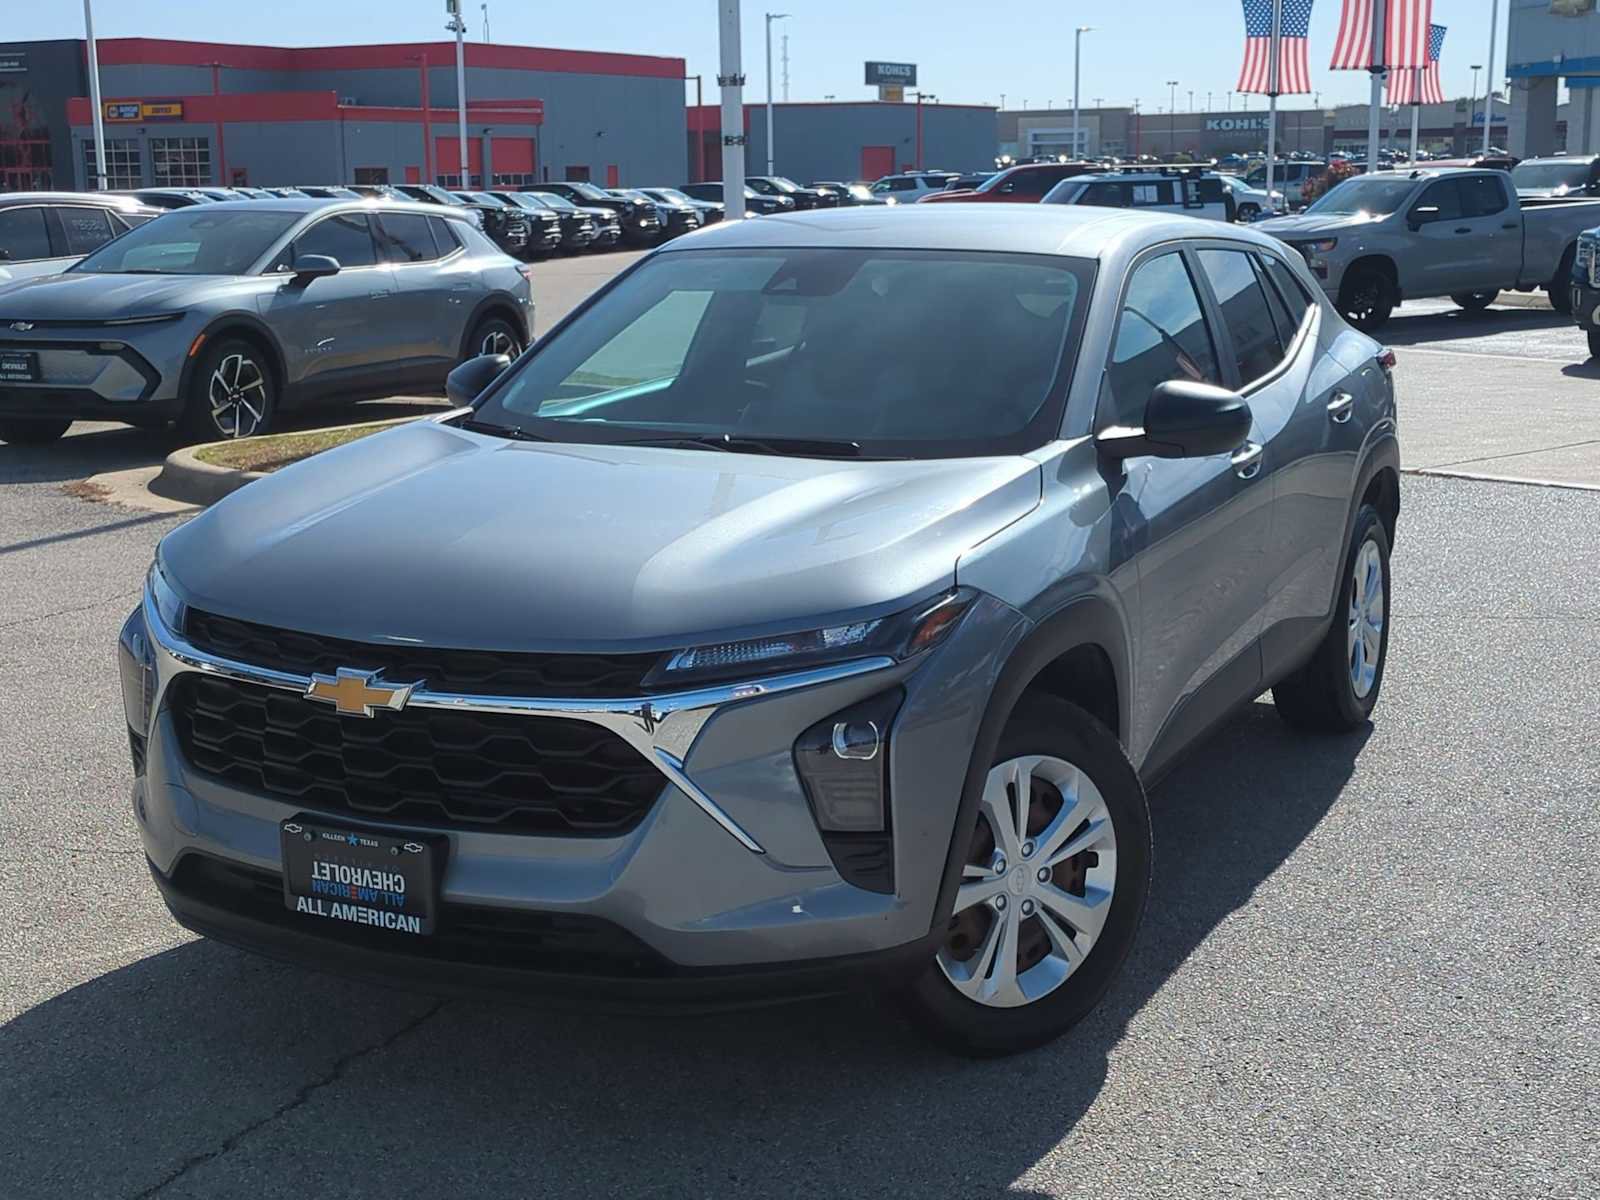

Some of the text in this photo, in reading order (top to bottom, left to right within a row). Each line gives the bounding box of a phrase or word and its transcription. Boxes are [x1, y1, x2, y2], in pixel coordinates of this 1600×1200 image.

[1207, 118, 1272, 129] KOHL'S
[322, 832, 378, 847] KILLEEN TEXAS
[312, 861, 405, 893] CHEVROLET
[312, 880, 405, 906] ALL AMERICAN
[297, 896, 421, 934] ALL AMERICAN
